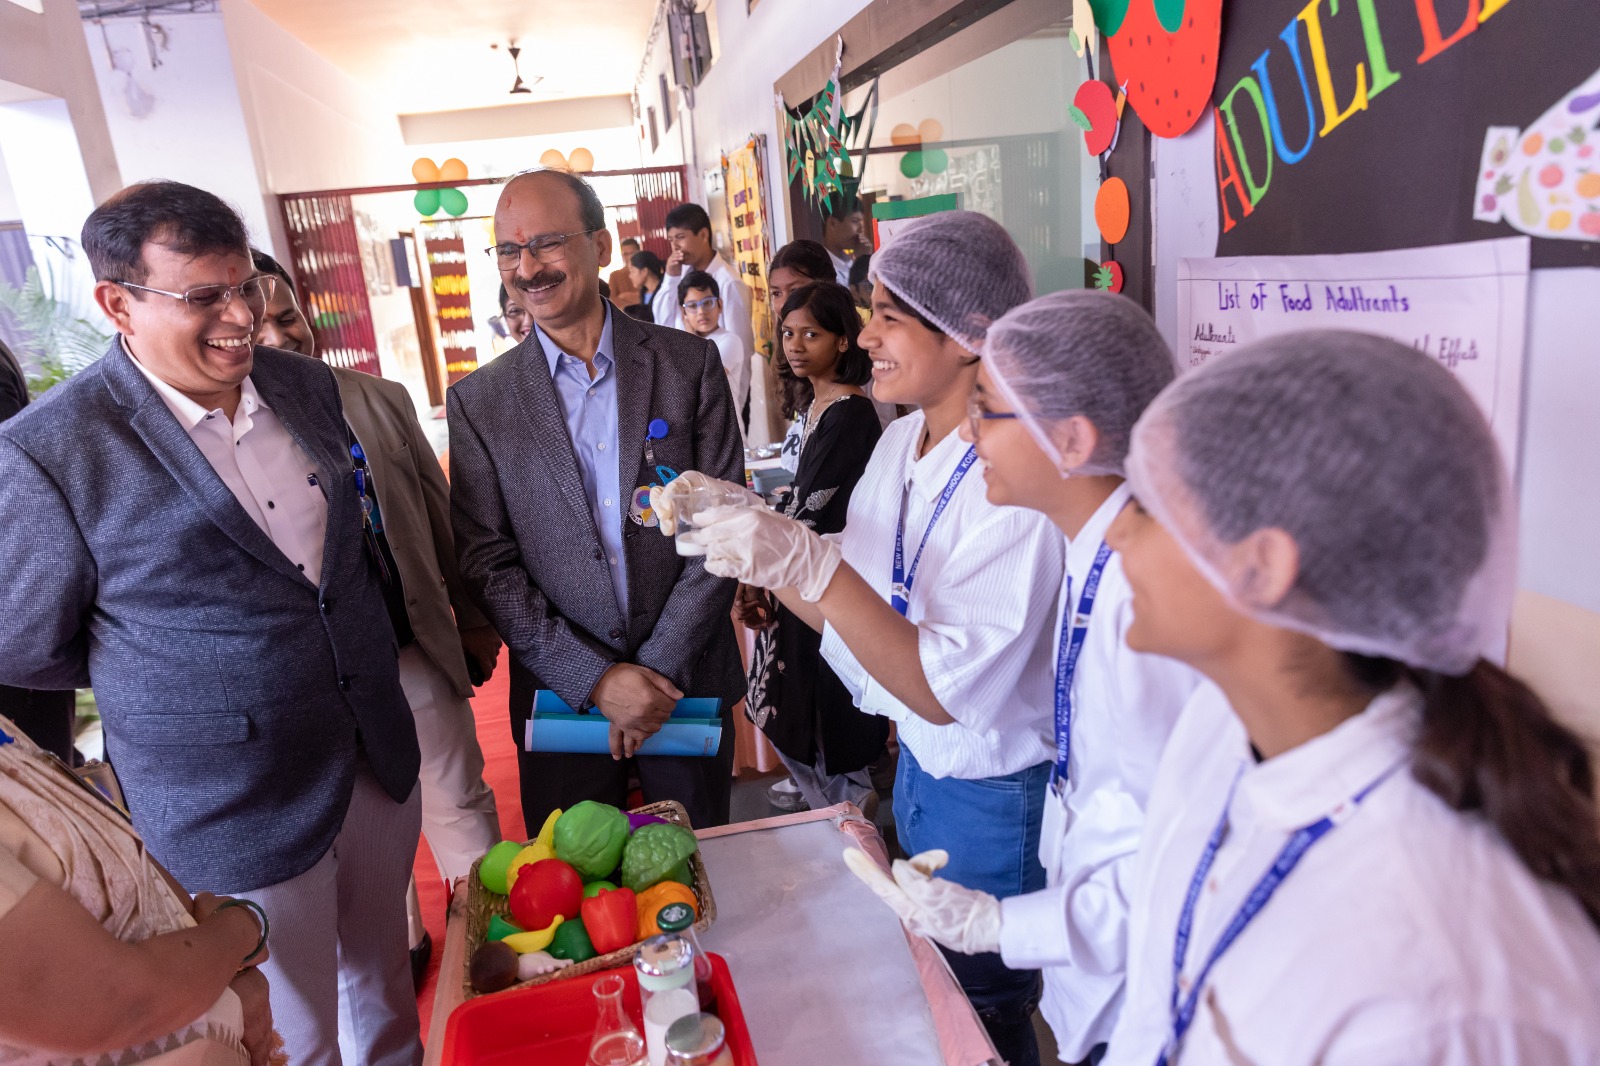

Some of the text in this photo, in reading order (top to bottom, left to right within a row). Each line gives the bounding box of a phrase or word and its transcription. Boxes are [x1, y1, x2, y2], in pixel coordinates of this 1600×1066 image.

[1215, 0, 1509, 233] ADULT
[1218, 282, 1240, 311] List
[1279, 283, 1312, 312] Food
[921, 499, 947, 546] PROGRESSIVE
[944, 471, 965, 499] SCHOOL
[1083, 568, 1101, 600] KORBA
[1058, 731, 1068, 762] KORBA
